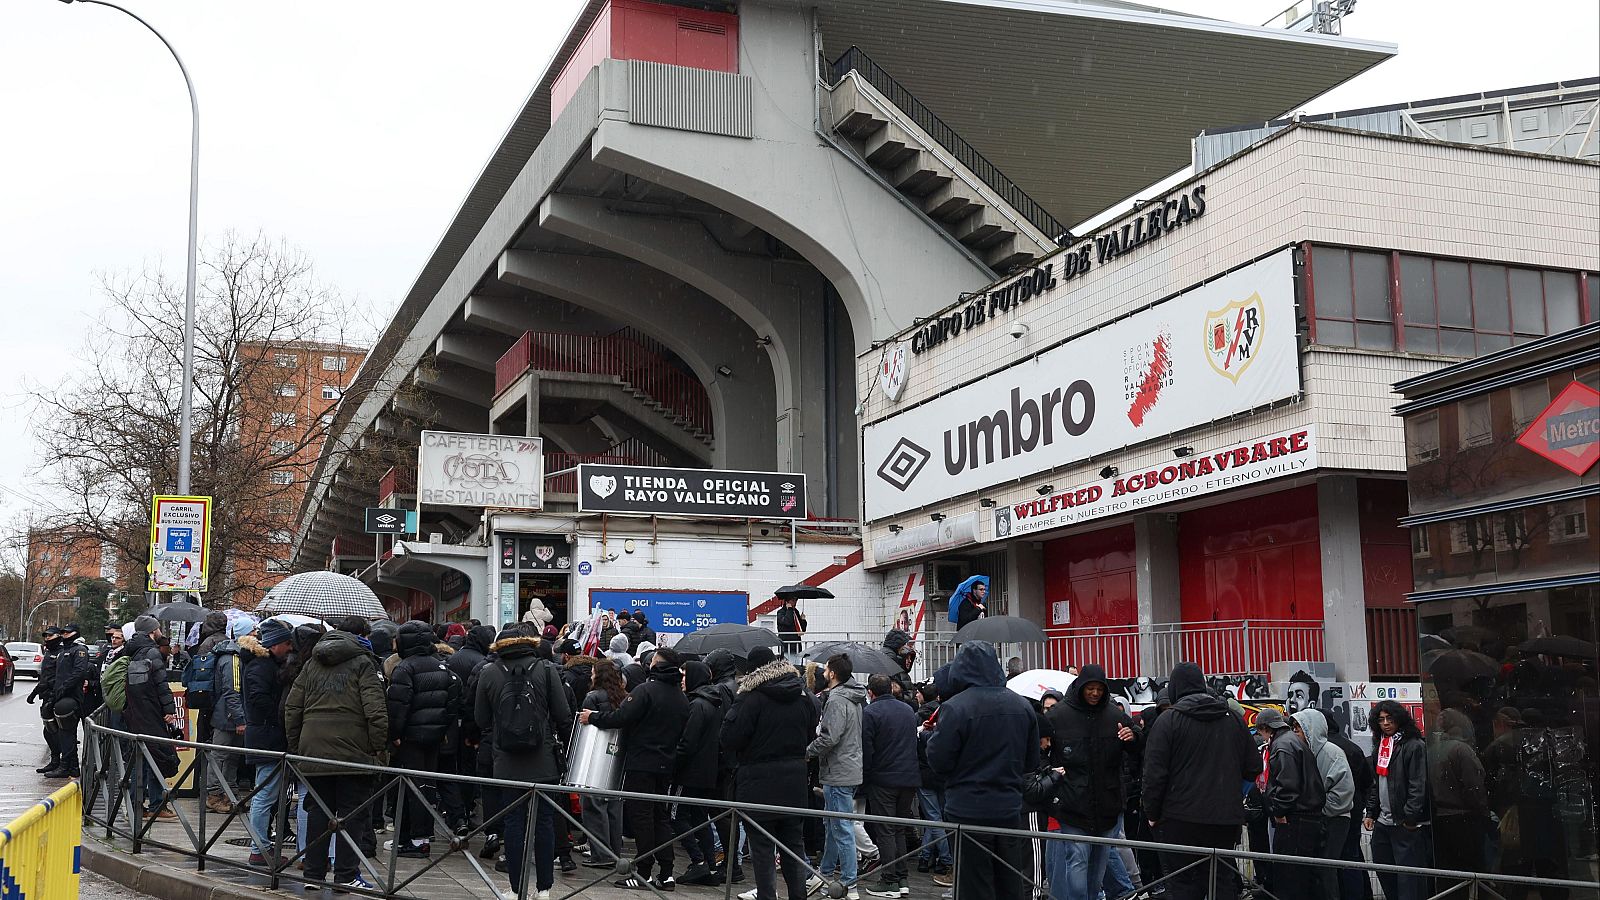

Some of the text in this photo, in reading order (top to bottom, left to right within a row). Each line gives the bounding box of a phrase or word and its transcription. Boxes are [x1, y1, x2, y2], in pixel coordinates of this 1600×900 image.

[911, 312, 963, 355] CAMPO
[963, 297, 987, 330] DE
[1063, 243, 1093, 280] DE
[1095, 185, 1206, 264] VALLECAS
[943, 379, 1096, 476] umbro
[1550, 418, 1600, 443] Metro
[424, 433, 515, 452] CAFETERIA
[624, 475, 770, 493] TIENDA OFICIAL
[1013, 430, 1309, 521] WILFRED AGBONAVBARE
[624, 490, 668, 503] RAYO
[674, 491, 770, 506] VALLECANO
[1015, 458, 1308, 533] SIEMPRE EN NUESTRO RECUERDO ETERNO WILLY
[631, 599, 649, 607] DIGI
[663, 618, 682, 627] 500
[696, 618, 709, 627] 50
